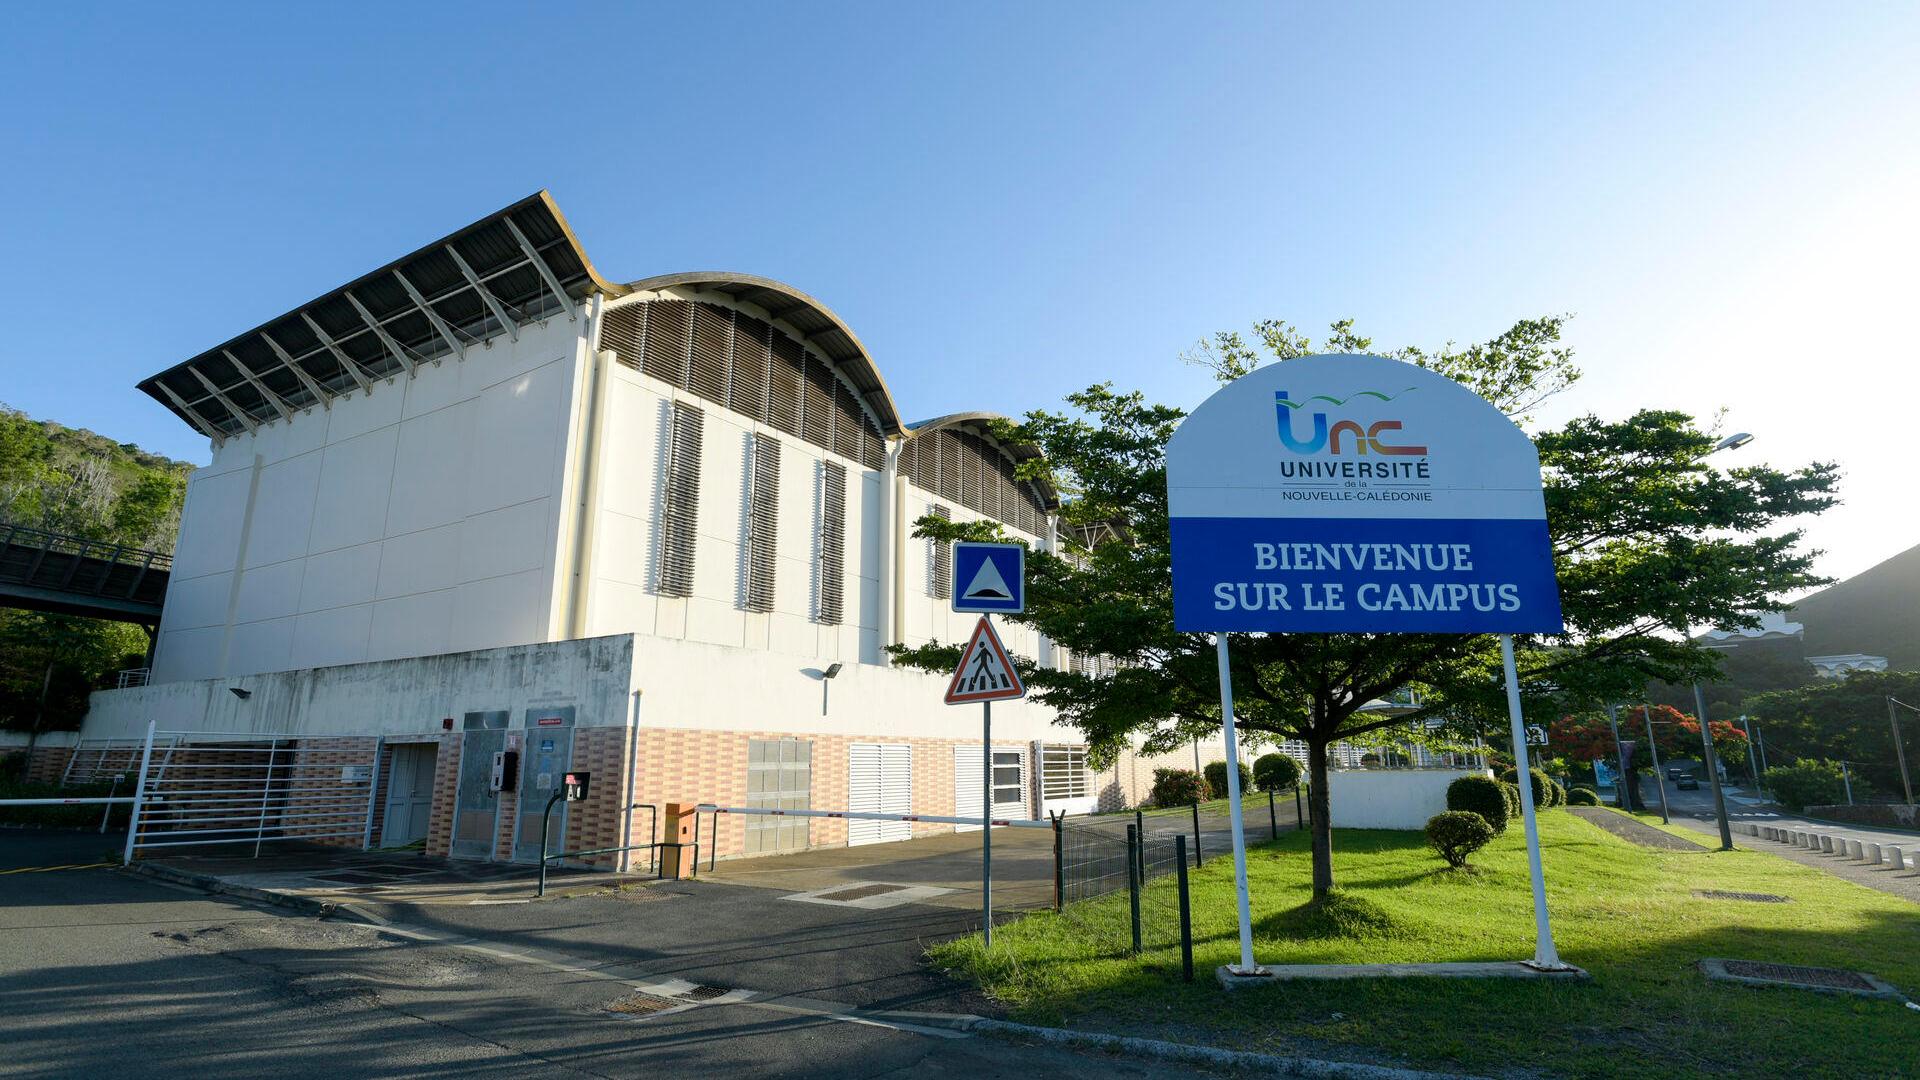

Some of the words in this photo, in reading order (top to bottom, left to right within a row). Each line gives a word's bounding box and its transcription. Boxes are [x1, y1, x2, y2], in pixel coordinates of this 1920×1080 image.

[1280, 457, 1431, 479] UNIVERSITÉ
[1344, 480, 1357, 488] de
[1358, 480, 1367, 488] la
[1282, 490, 1433, 502] NOUVELLE-CALÉDONIE
[1253, 542, 1473, 572] BIENVENUE
[1213, 582, 1292, 611] SUR
[1303, 583, 1346, 611] LE
[1356, 583, 1522, 612] CAMPUS
